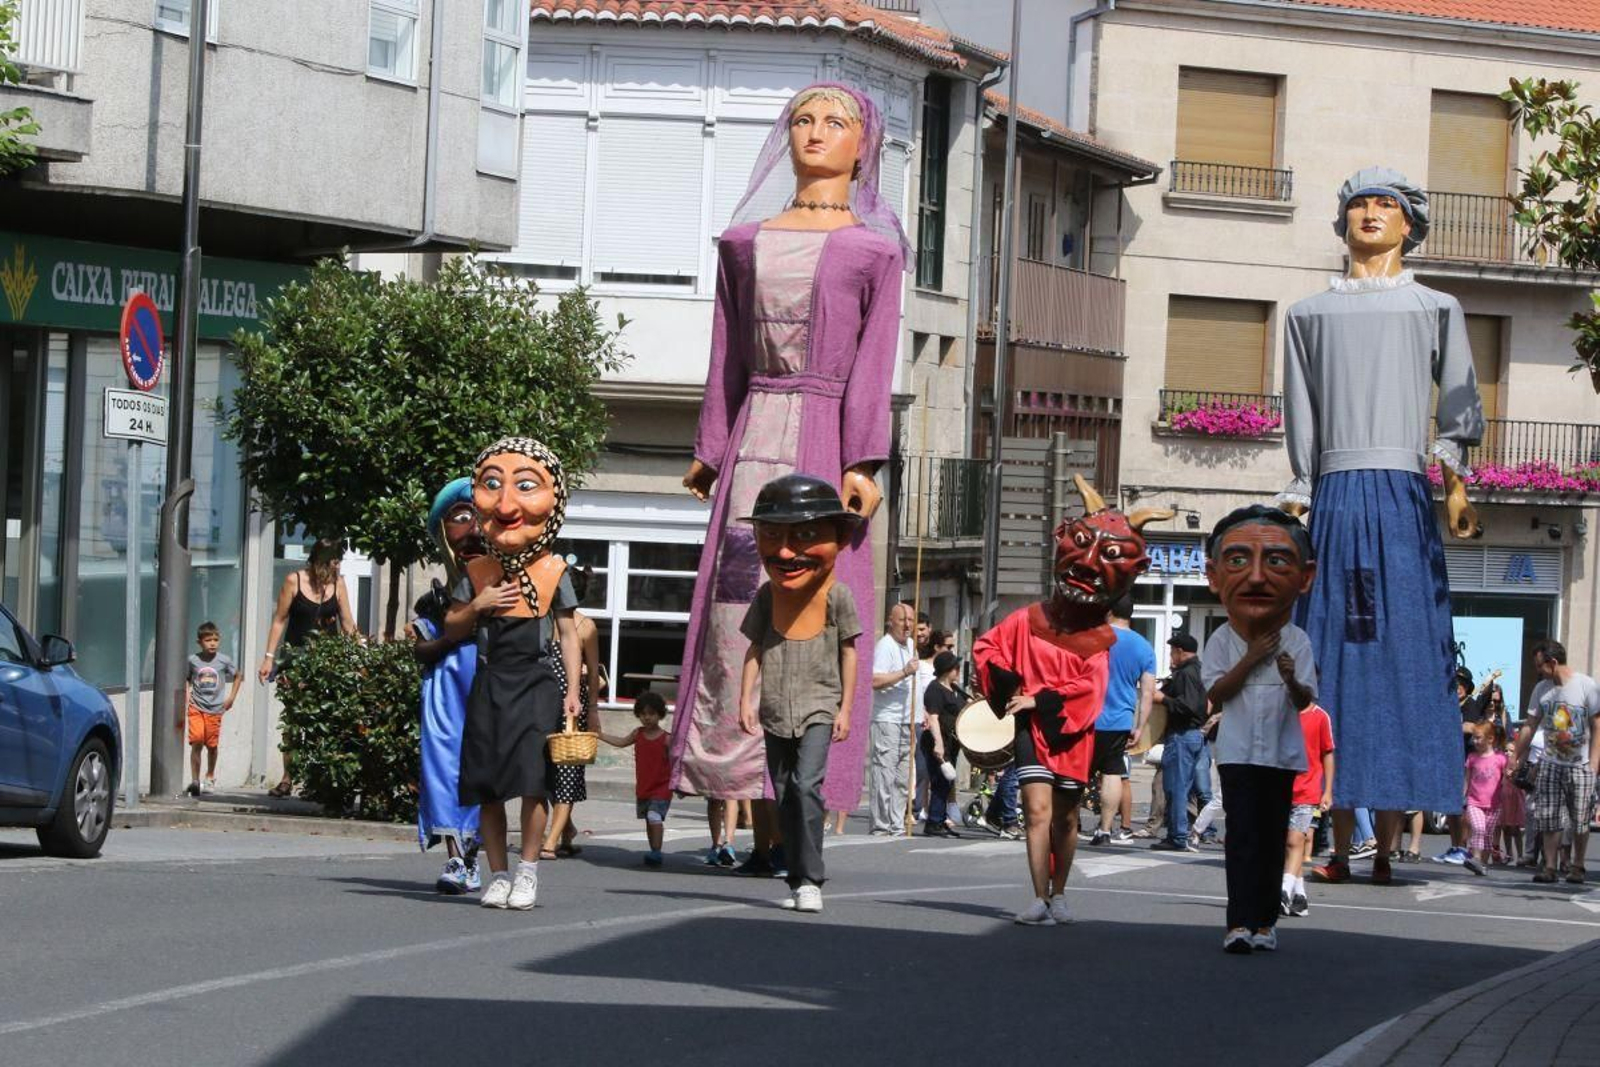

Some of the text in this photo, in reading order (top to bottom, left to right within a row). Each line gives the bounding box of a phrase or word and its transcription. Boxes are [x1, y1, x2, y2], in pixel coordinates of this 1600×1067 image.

[52, 261, 115, 305] CAIXA
[197, 277, 259, 319] ALEGA
[111, 398, 141, 411] TODOS
[129, 418, 143, 431] 24
[1147, 545, 1206, 573] ABA
